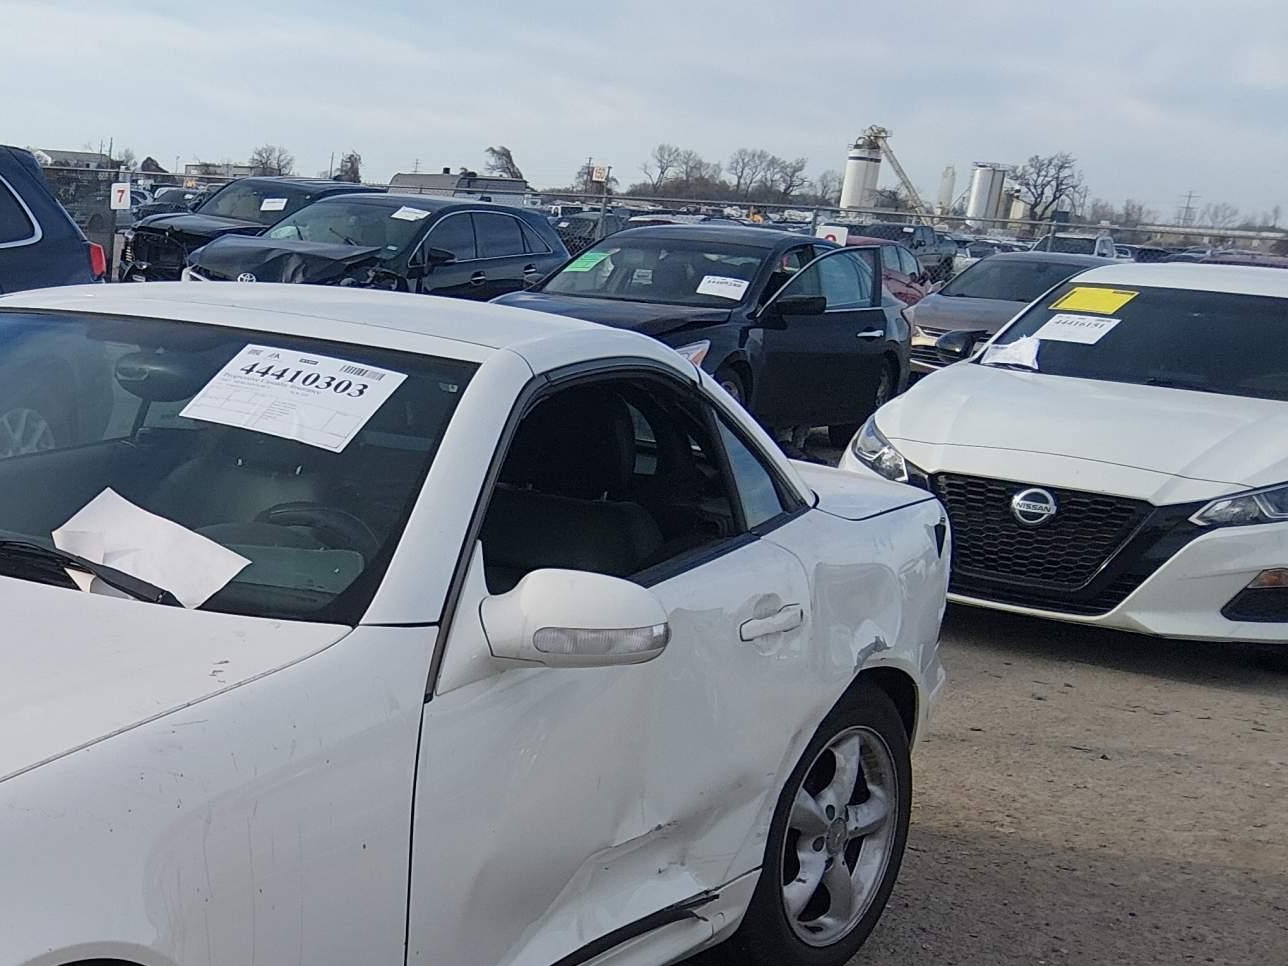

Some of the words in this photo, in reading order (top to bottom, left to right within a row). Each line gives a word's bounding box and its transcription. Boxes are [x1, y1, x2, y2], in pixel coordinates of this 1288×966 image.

[117, 189, 126, 203] 7
[240, 362, 369, 397] 44410303
[1016, 502, 1051, 513] NISSAN
